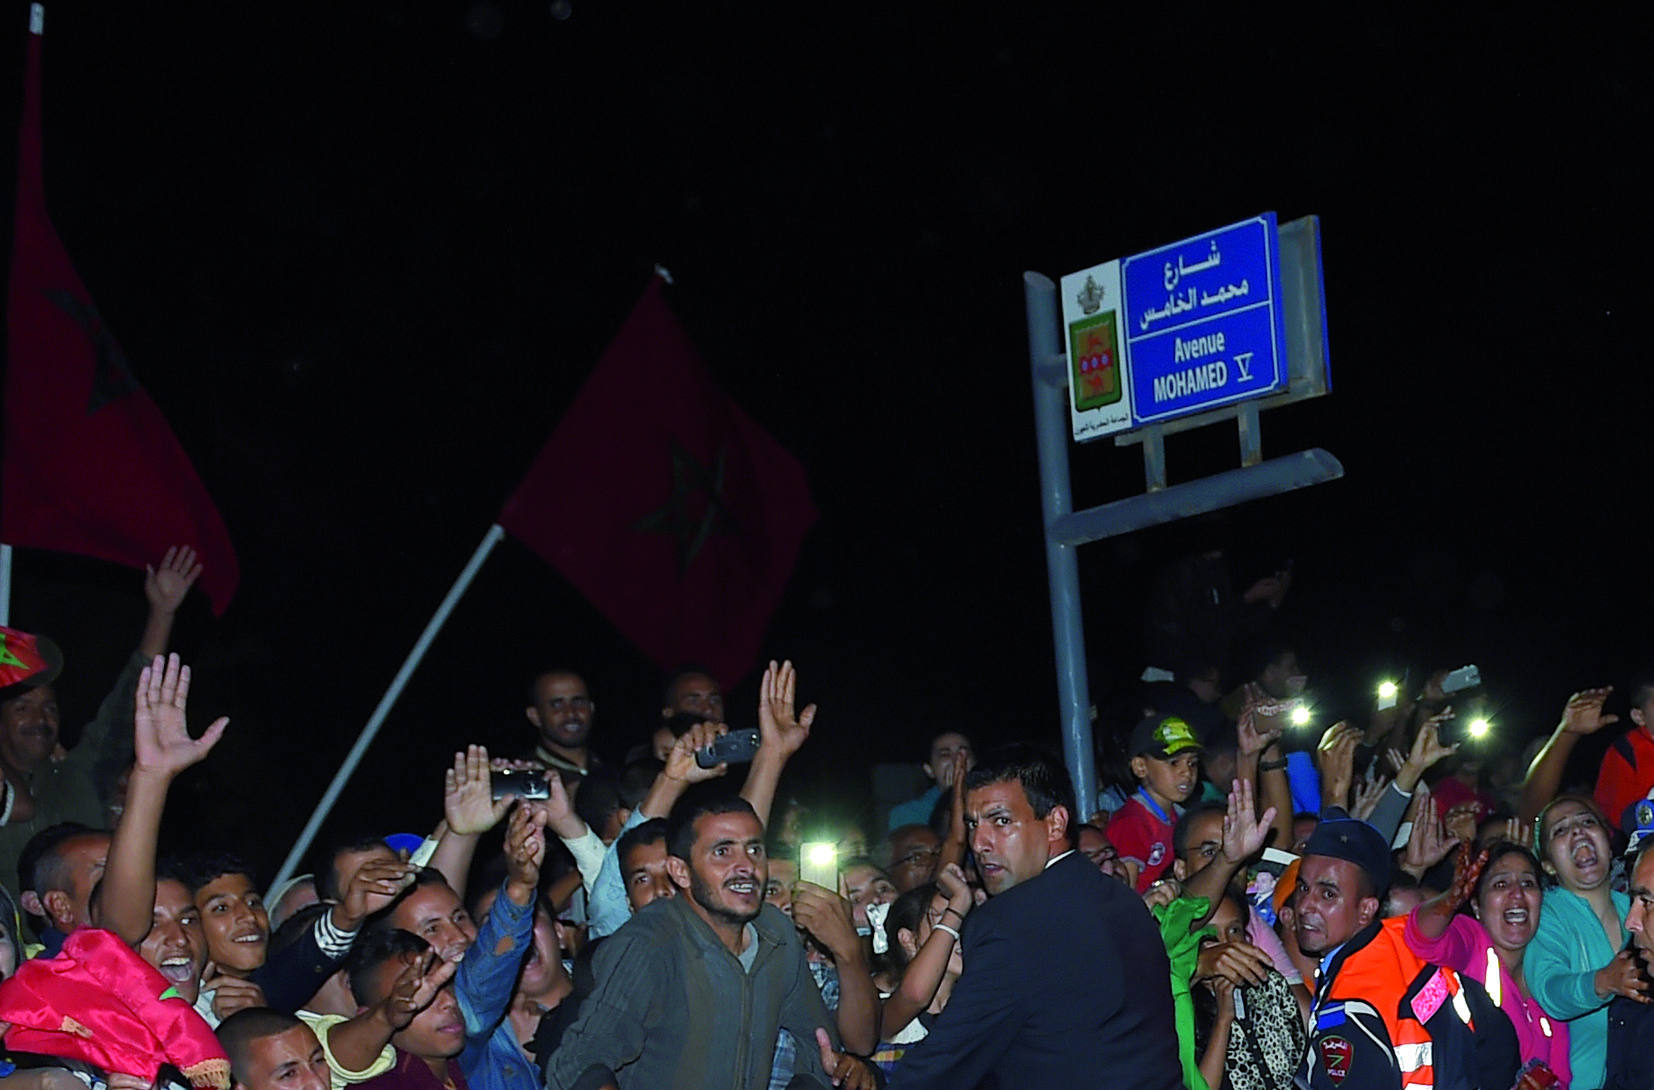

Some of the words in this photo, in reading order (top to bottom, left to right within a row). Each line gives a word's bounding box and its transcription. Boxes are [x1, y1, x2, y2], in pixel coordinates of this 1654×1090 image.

[1164, 240, 1220, 290] شارع
[1140, 286, 1197, 330] الخامس
[1201, 279, 1249, 306] محمد
[1175, 332, 1225, 364] Avenue
[1154, 361, 1227, 403] MOHAMED
[1233, 352, 1254, 382] V
